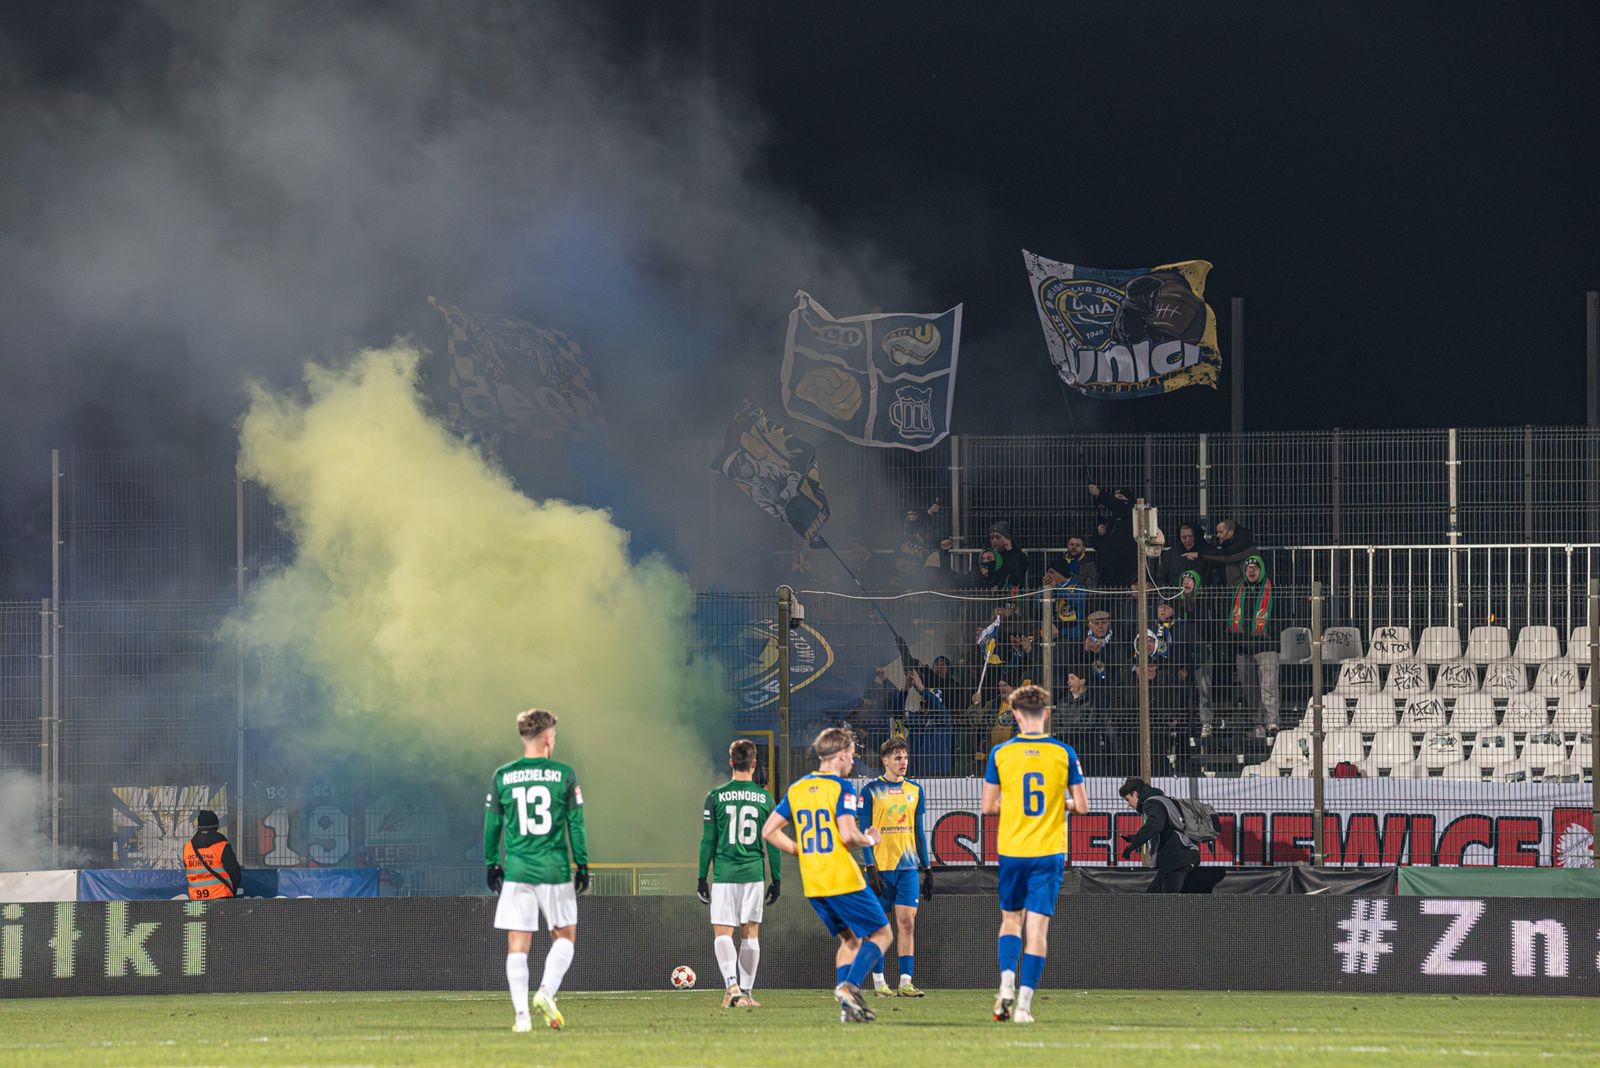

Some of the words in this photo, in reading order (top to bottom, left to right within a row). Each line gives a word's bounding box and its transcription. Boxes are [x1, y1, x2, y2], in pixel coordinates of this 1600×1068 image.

[503, 769, 562, 785] NIEDZIELSKI
[719, 790, 766, 804] KORNOBIS
[1023, 772, 1045, 816] 6
[512, 785, 552, 836] 13
[726, 805, 758, 845] 16
[797, 809, 833, 854] 26
[196, 889, 209, 899] 99
[1334, 899, 1600, 978] #Zn
